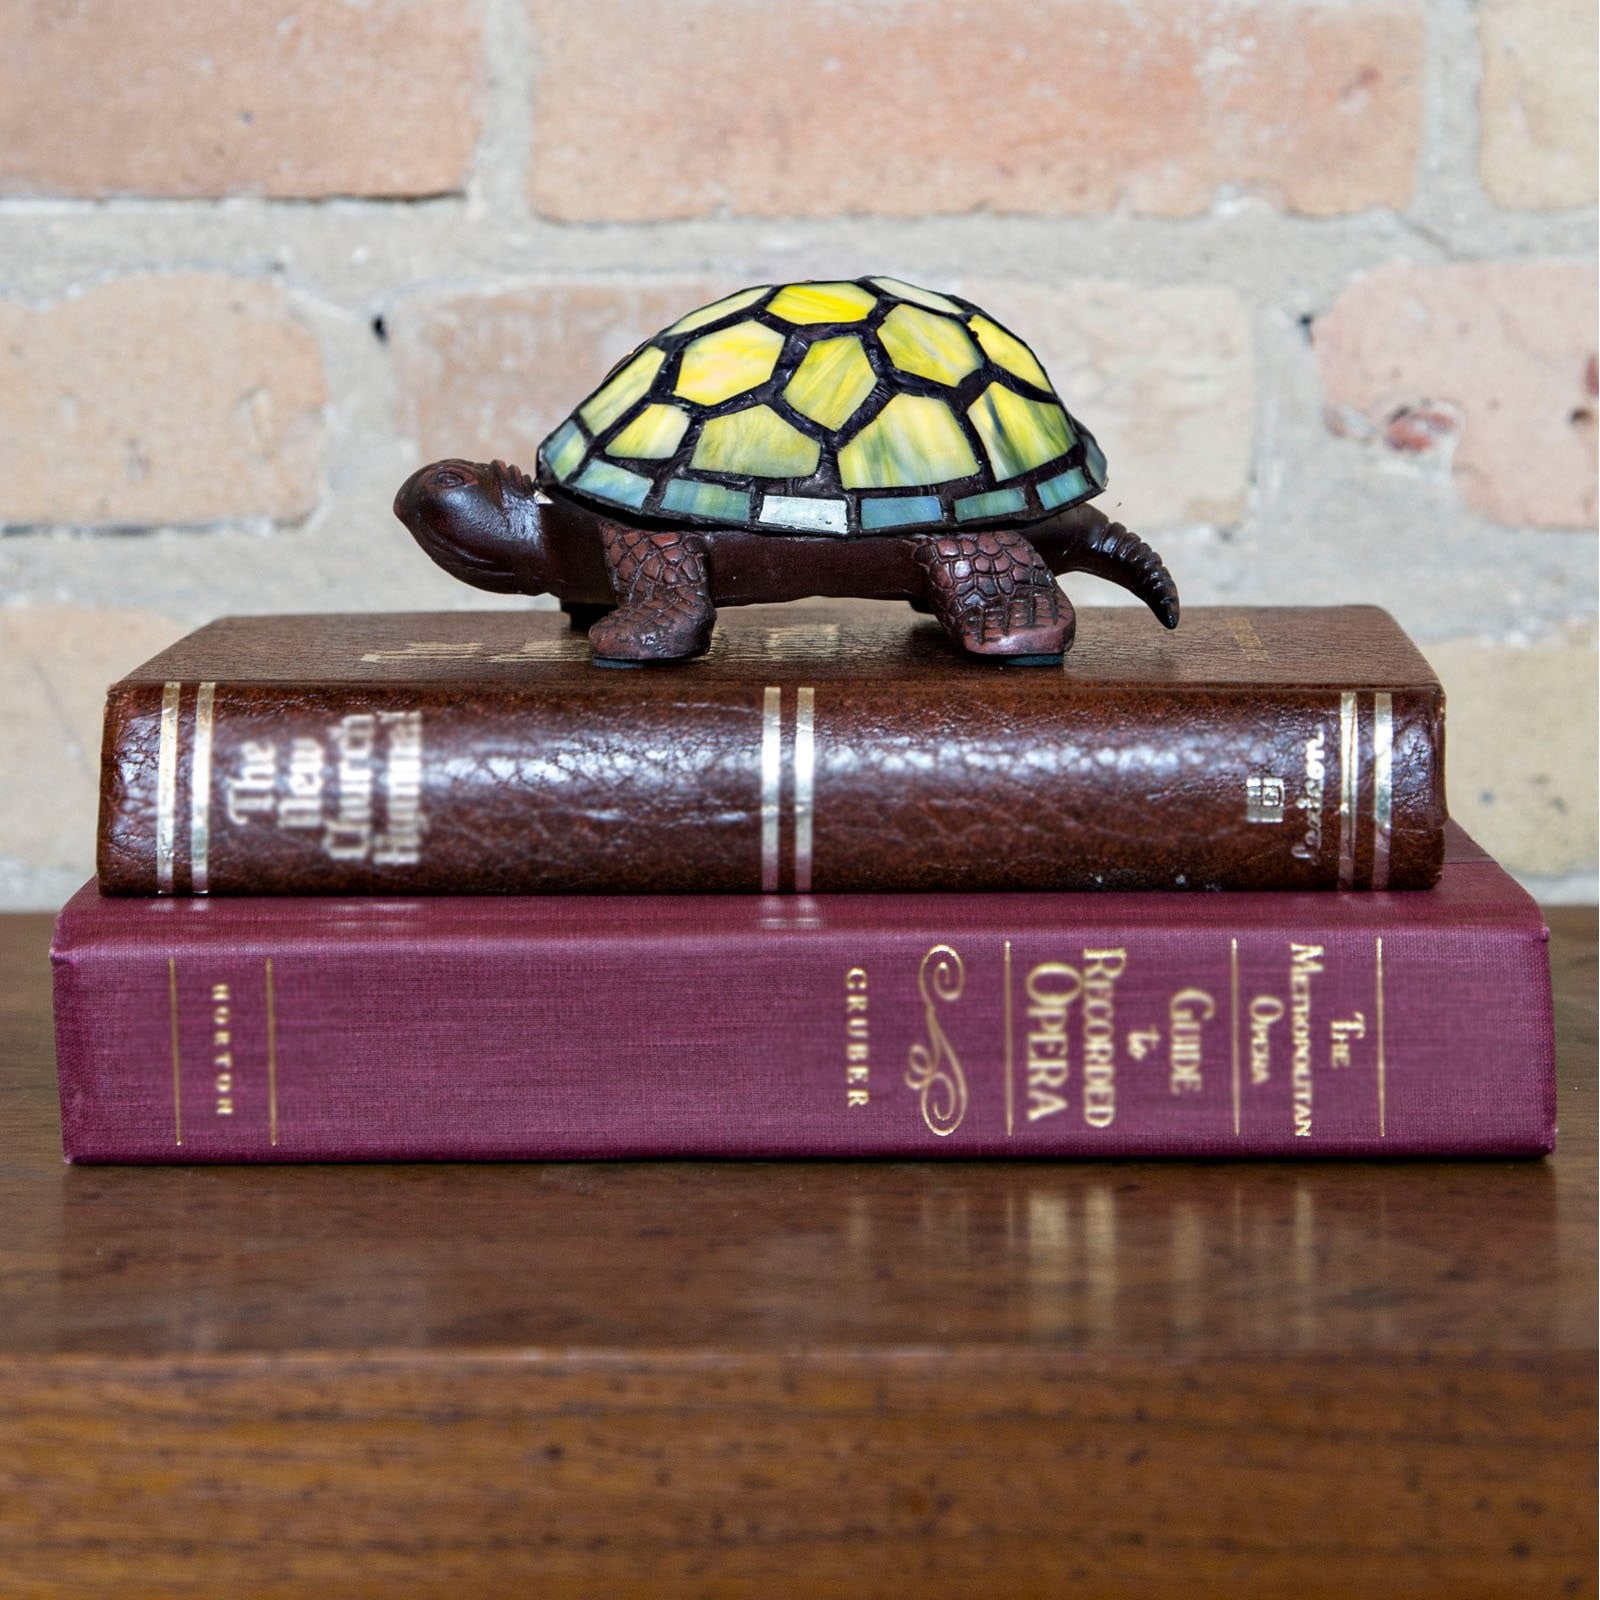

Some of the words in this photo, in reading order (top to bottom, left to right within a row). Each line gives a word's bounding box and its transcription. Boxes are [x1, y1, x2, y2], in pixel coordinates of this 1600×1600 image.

[226, 740, 276, 826] The
[278, 737, 324, 828] New
[322, 714, 376, 860] Church
[372, 709, 430, 864] Hymnal
[211, 983, 234, 1115] NORTON
[847, 967, 870, 1108] GRUBER
[1026, 962, 1084, 1122] OPERA
[1082, 947, 1128, 1128] RECORDED
[1128, 1024, 1161, 1060] to
[1169, 987, 1216, 1094] GUIDE
[1250, 995, 1285, 1085] OPERA
[1290, 942, 1324, 1137] METROPOLITAN
[1331, 1012, 1366, 1069] THE
